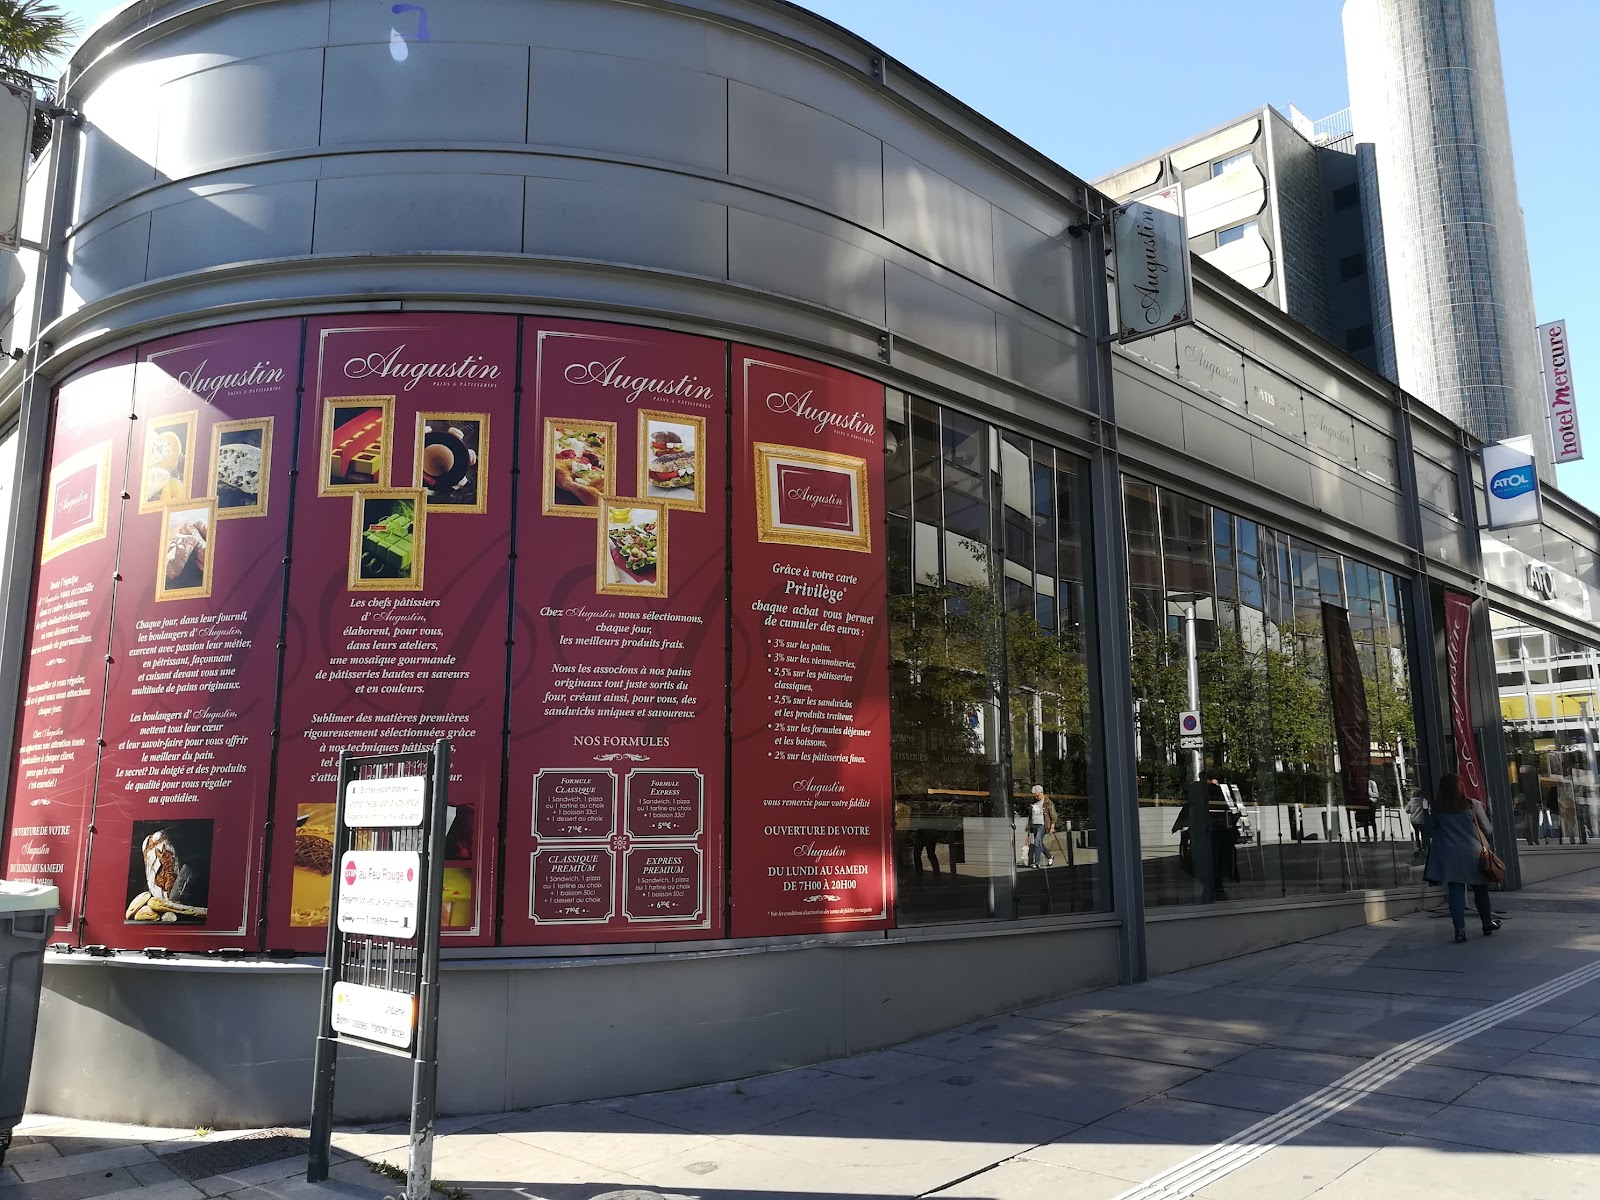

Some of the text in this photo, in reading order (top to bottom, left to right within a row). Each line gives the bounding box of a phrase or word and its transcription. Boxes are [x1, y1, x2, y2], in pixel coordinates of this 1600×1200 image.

[1134, 208, 1169, 324] Augustin
[344, 344, 501, 391] Augustin
[1184, 345, 1240, 386] Augustin
[163, 359, 285, 404] Augustin
[564, 356, 713, 403] Augustin
[766, 390, 876, 436] Augustin
[1556, 408, 1578, 457] hotel
[1493, 474, 1529, 488] ATOL
[788, 486, 843, 507] Augustin
[772, 563, 858, 584] Grâce à votre carte
[350, 598, 440, 610] Les chefs pâtissiers
[540, 606, 703, 624] Chez Augustin nous sélectionnons,
[752, 600, 874, 624] chaque achat vous permet
[136, 611, 247, 630] Chaque jour, dans leur fournil,
[764, 615, 777, 626] de
[780, 618, 818, 630] cumuler
[820, 621, 835, 632] des
[138, 633, 147, 642] les
[149, 629, 187, 641] boulangers
[343, 626, 443, 637] élaborent, pour vous,
[596, 623, 652, 635] chaque jour,
[129, 640, 251, 656] exercent avec passion leur métier,
[347, 640, 438, 650] dans leurs ateliers,
[560, 635, 685, 650] les meilleurs produits frais.
[350, 656, 396, 666] mosaïque
[397, 655, 456, 666] gourmande
[316, 669, 470, 681] de pâtisseries hautes en saveurs
[552, 664, 576, 673] Nous
[578, 664, 591, 673] les
[593, 665, 638, 674] associons
[640, 665, 647, 675] à
[666, 667, 691, 678] pains
[355, 684, 425, 693] et en couleurs.
[554, 678, 688, 690] originaux tout juste sortis du
[542, 692, 697, 705] four, créant ainsi, pour vous, des
[311, 713, 469, 724] Sublimer des matières premières
[544, 706, 695, 718] sandwichs uniques et savoureux.
[304, 728, 476, 740] rigoureusement sélectionnées grâce
[573, 736, 670, 747] NOS FORMULES
[40, 826, 48, 835] DE
[49, 826, 70, 835] VOTRE
[764, 826, 870, 835] OUVERTURE DE VOTRE
[793, 841, 846, 863] Augustin
[548, 855, 598, 865] CLASSIQUE
[646, 857, 682, 865] EXPRESS
[551, 864, 595, 873] PREMIUM
[642, 866, 684, 874] PREMIUM
[768, 865, 868, 876] DU LUNDI AU SAMEDI
[345, 868, 403, 883] STOP au Feu Rouge
[783, 881, 797, 891] DE
[799, 881, 822, 890] 7H00
[831, 880, 857, 889] 20H00
